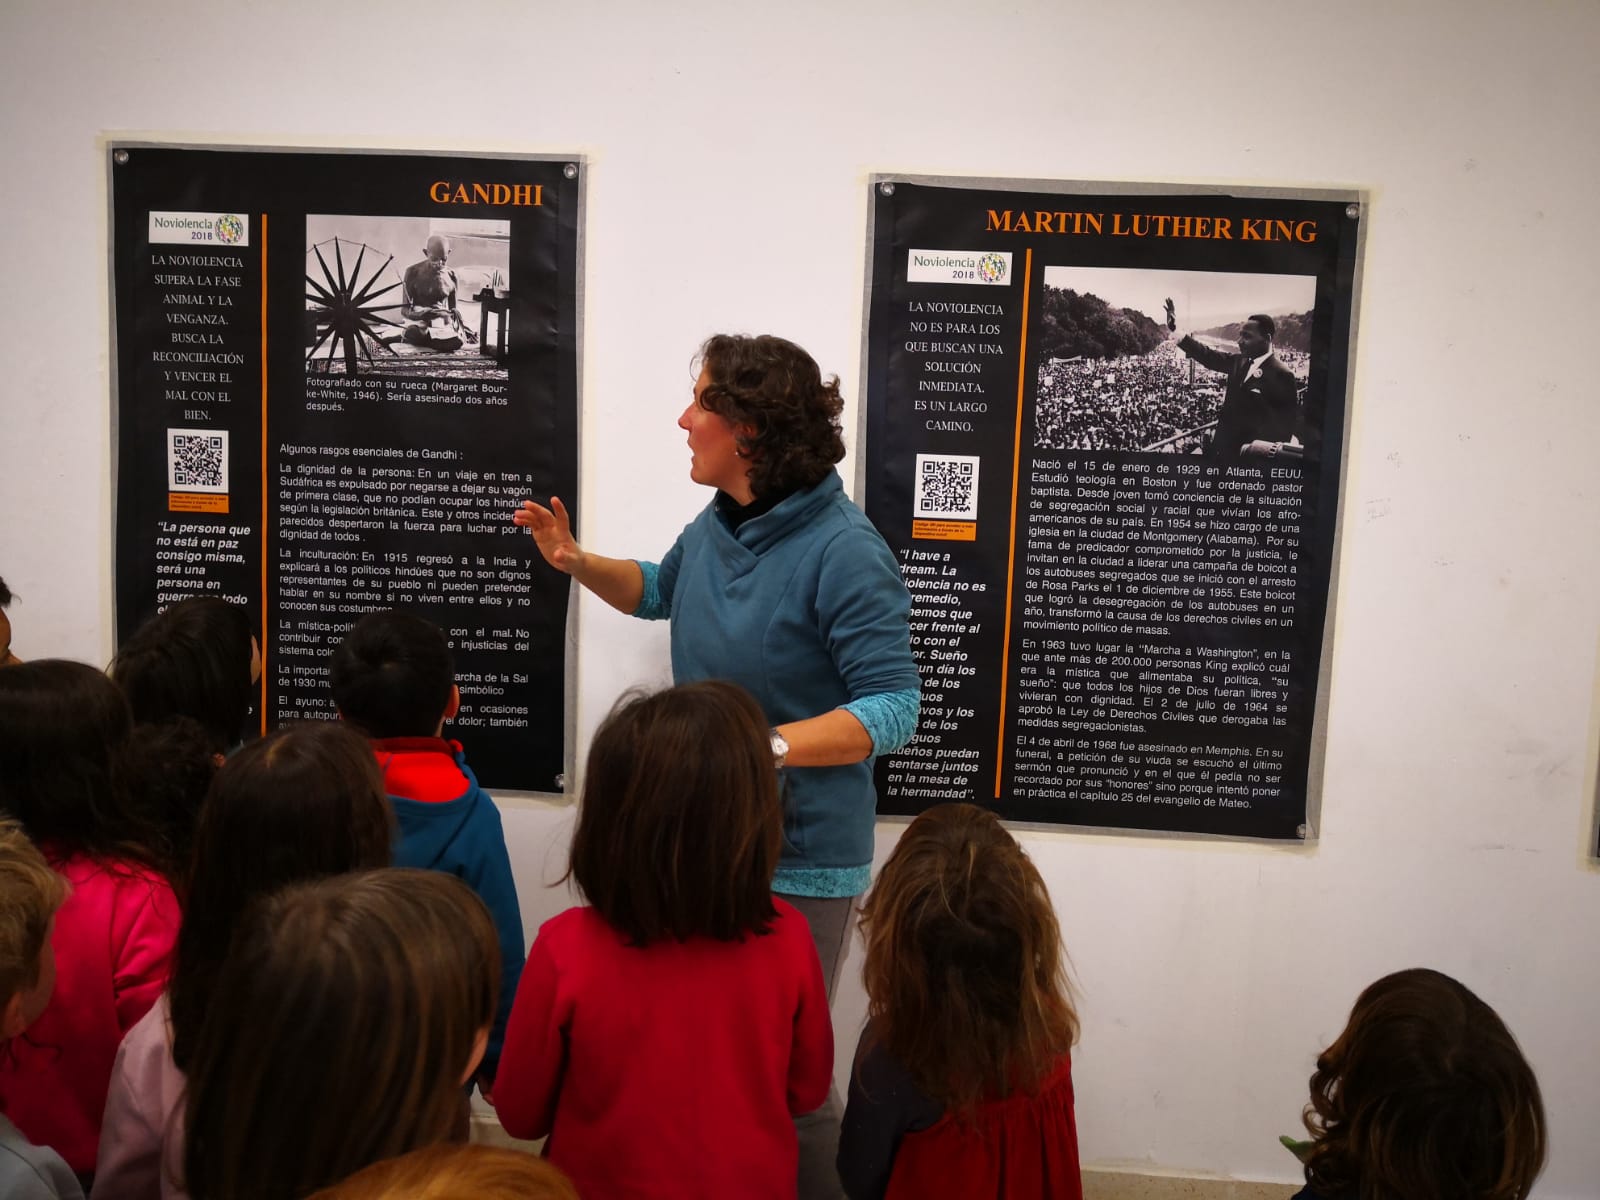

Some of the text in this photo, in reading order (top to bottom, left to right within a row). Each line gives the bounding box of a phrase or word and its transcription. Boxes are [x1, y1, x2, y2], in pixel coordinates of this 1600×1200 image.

[430, 182, 542, 205] GANDHI
[154, 217, 213, 229] Noviolencia
[986, 209, 1316, 242] MARTIN LUTHER KING
[191, 231, 212, 240] 2018
[151, 255, 243, 267] LA NOVIOLENCIA
[914, 255, 975, 268] Noviolencia
[154, 274, 241, 286] SUPERA LA FASE
[952, 270, 974, 279] 2018
[162, 294, 233, 305] ANIMAL Y LA
[909, 301, 1003, 315] LA NOVIOLENCIA
[166, 313, 228, 325] VENGANZA.
[910, 321, 1000, 334] NO ES PARA LOS
[171, 332, 224, 344] BUSCA LA
[904, 341, 1003, 354] QUE BUSCAN UNA
[152, 351, 243, 364] RECONCILIACIÓN
[924, 361, 981, 373] SOLUCIÓN
[164, 370, 232, 383] Y VENCER EL
[306, 378, 507, 393] Fotografiado con su rueca (Margaret Bour-
[919, 380, 984, 393] INMEDIATA.
[165, 389, 231, 402] MAL CON EL
[306, 390, 508, 405] ke-White, 1946). Sería asesinado dos años
[306, 401, 344, 412] después.
[914, 400, 987, 412] ES UN LARGO
[184, 409, 211, 420] BIEN.
[925, 420, 973, 431] CAMINO.
[279, 443, 317, 455] Algunos
[319, 447, 350, 457] rasgos
[352, 447, 404, 457] esenciales
[406, 448, 419, 458] de
[421, 448, 457, 459] Gandhi
[279, 463, 291, 472] La
[296, 463, 335, 475] dignidad
[340, 465, 352, 475] de
[358, 466, 366, 475] la
[372, 468, 415, 478] persona:
[417, 468, 431, 478] En
[455, 470, 478, 482] viaje
[483, 472, 495, 480] en
[501, 472, 520, 481] tren
[525, 474, 532, 482] a
[1032, 458, 1061, 469] Nació
[1067, 460, 1076, 470] el
[1084, 461, 1096, 470] 15
[1102, 461, 1115, 471] de
[1121, 464, 1150, 472] enero
[1156, 463, 1169, 473] de
[1176, 464, 1200, 474] 1929
[1206, 467, 1219, 475] en
[1270, 468, 1303, 478] EEUU.
[178, 524, 226, 534] persona
[228, 526, 251, 537] que
[156, 536, 239, 550] no está en paz
[156, 551, 245, 564] consigo misma,
[279, 548, 531, 569] La inculturación: En 1915 regresó a la India y
[911, 549, 940, 561] have
[942, 553, 950, 561] a
[156, 563, 206, 575] será una
[941, 565, 957, 576] La
[156, 579, 220, 589] persona en
[949, 610, 972, 621] que
[931, 621, 981, 633] frente al
[1022, 638, 1036, 648] En
[1041, 640, 1065, 649] 1963
[1070, 641, 1091, 651] tuvo
[1095, 642, 1120, 654] lugar
[1125, 643, 1134, 653] la
[1185, 648, 1192, 656] a
[1264, 651, 1277, 659] en
[1281, 650, 1291, 659] la
[930, 649, 968, 661] Sueño
[936, 664, 976, 675] día los
[924, 677, 960, 688] de los
[479, 705, 528, 714] ocasiones
[458, 716, 528, 727] dolor; también
[935, 749, 980, 760] puedan
[888, 760, 979, 773] sentarse juntos
[887, 772, 968, 785] en la mesa de
[887, 785, 898, 795] la
[1028, 787, 1066, 798] práctica
[1068, 789, 1078, 799] el
[1080, 791, 1118, 801] capítulo
[1120, 792, 1134, 802] 25
[1135, 793, 1151, 803] del
[1153, 796, 1201, 807] evangelio
[1203, 797, 1216, 806] de
[1218, 797, 1252, 808] Mateo.
